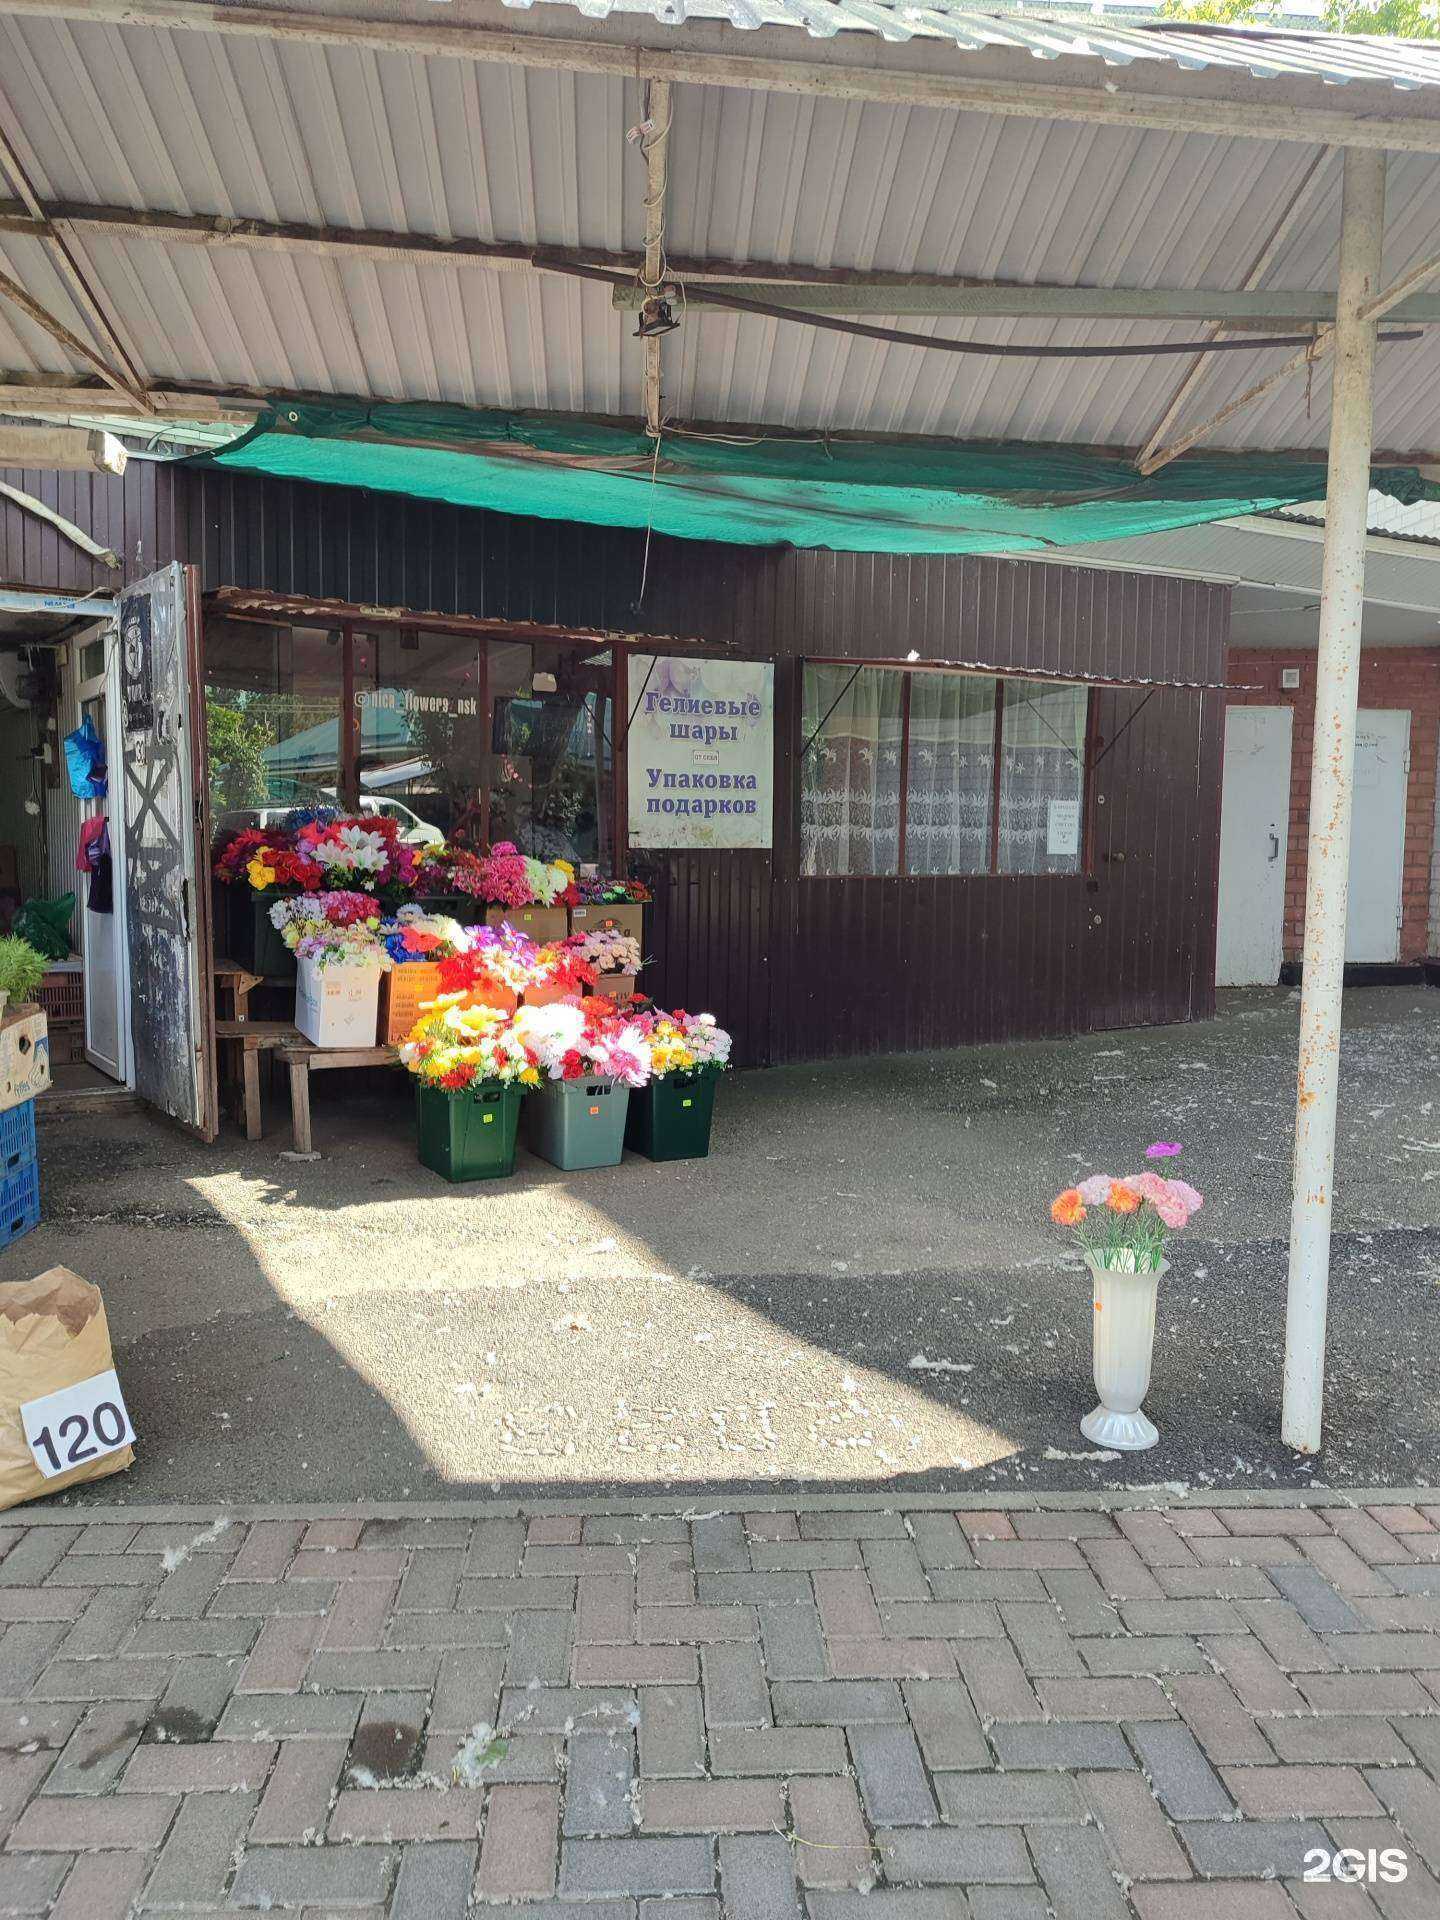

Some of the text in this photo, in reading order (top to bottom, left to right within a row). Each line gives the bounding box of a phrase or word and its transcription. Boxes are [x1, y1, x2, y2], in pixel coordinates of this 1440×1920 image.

[645, 692, 762, 717] Гелиевые
[669, 723, 739, 745] шары
[645, 768, 757, 790] Упаковка
[646, 797, 757, 818] подарков
[32, 1401, 126, 1470] 120
